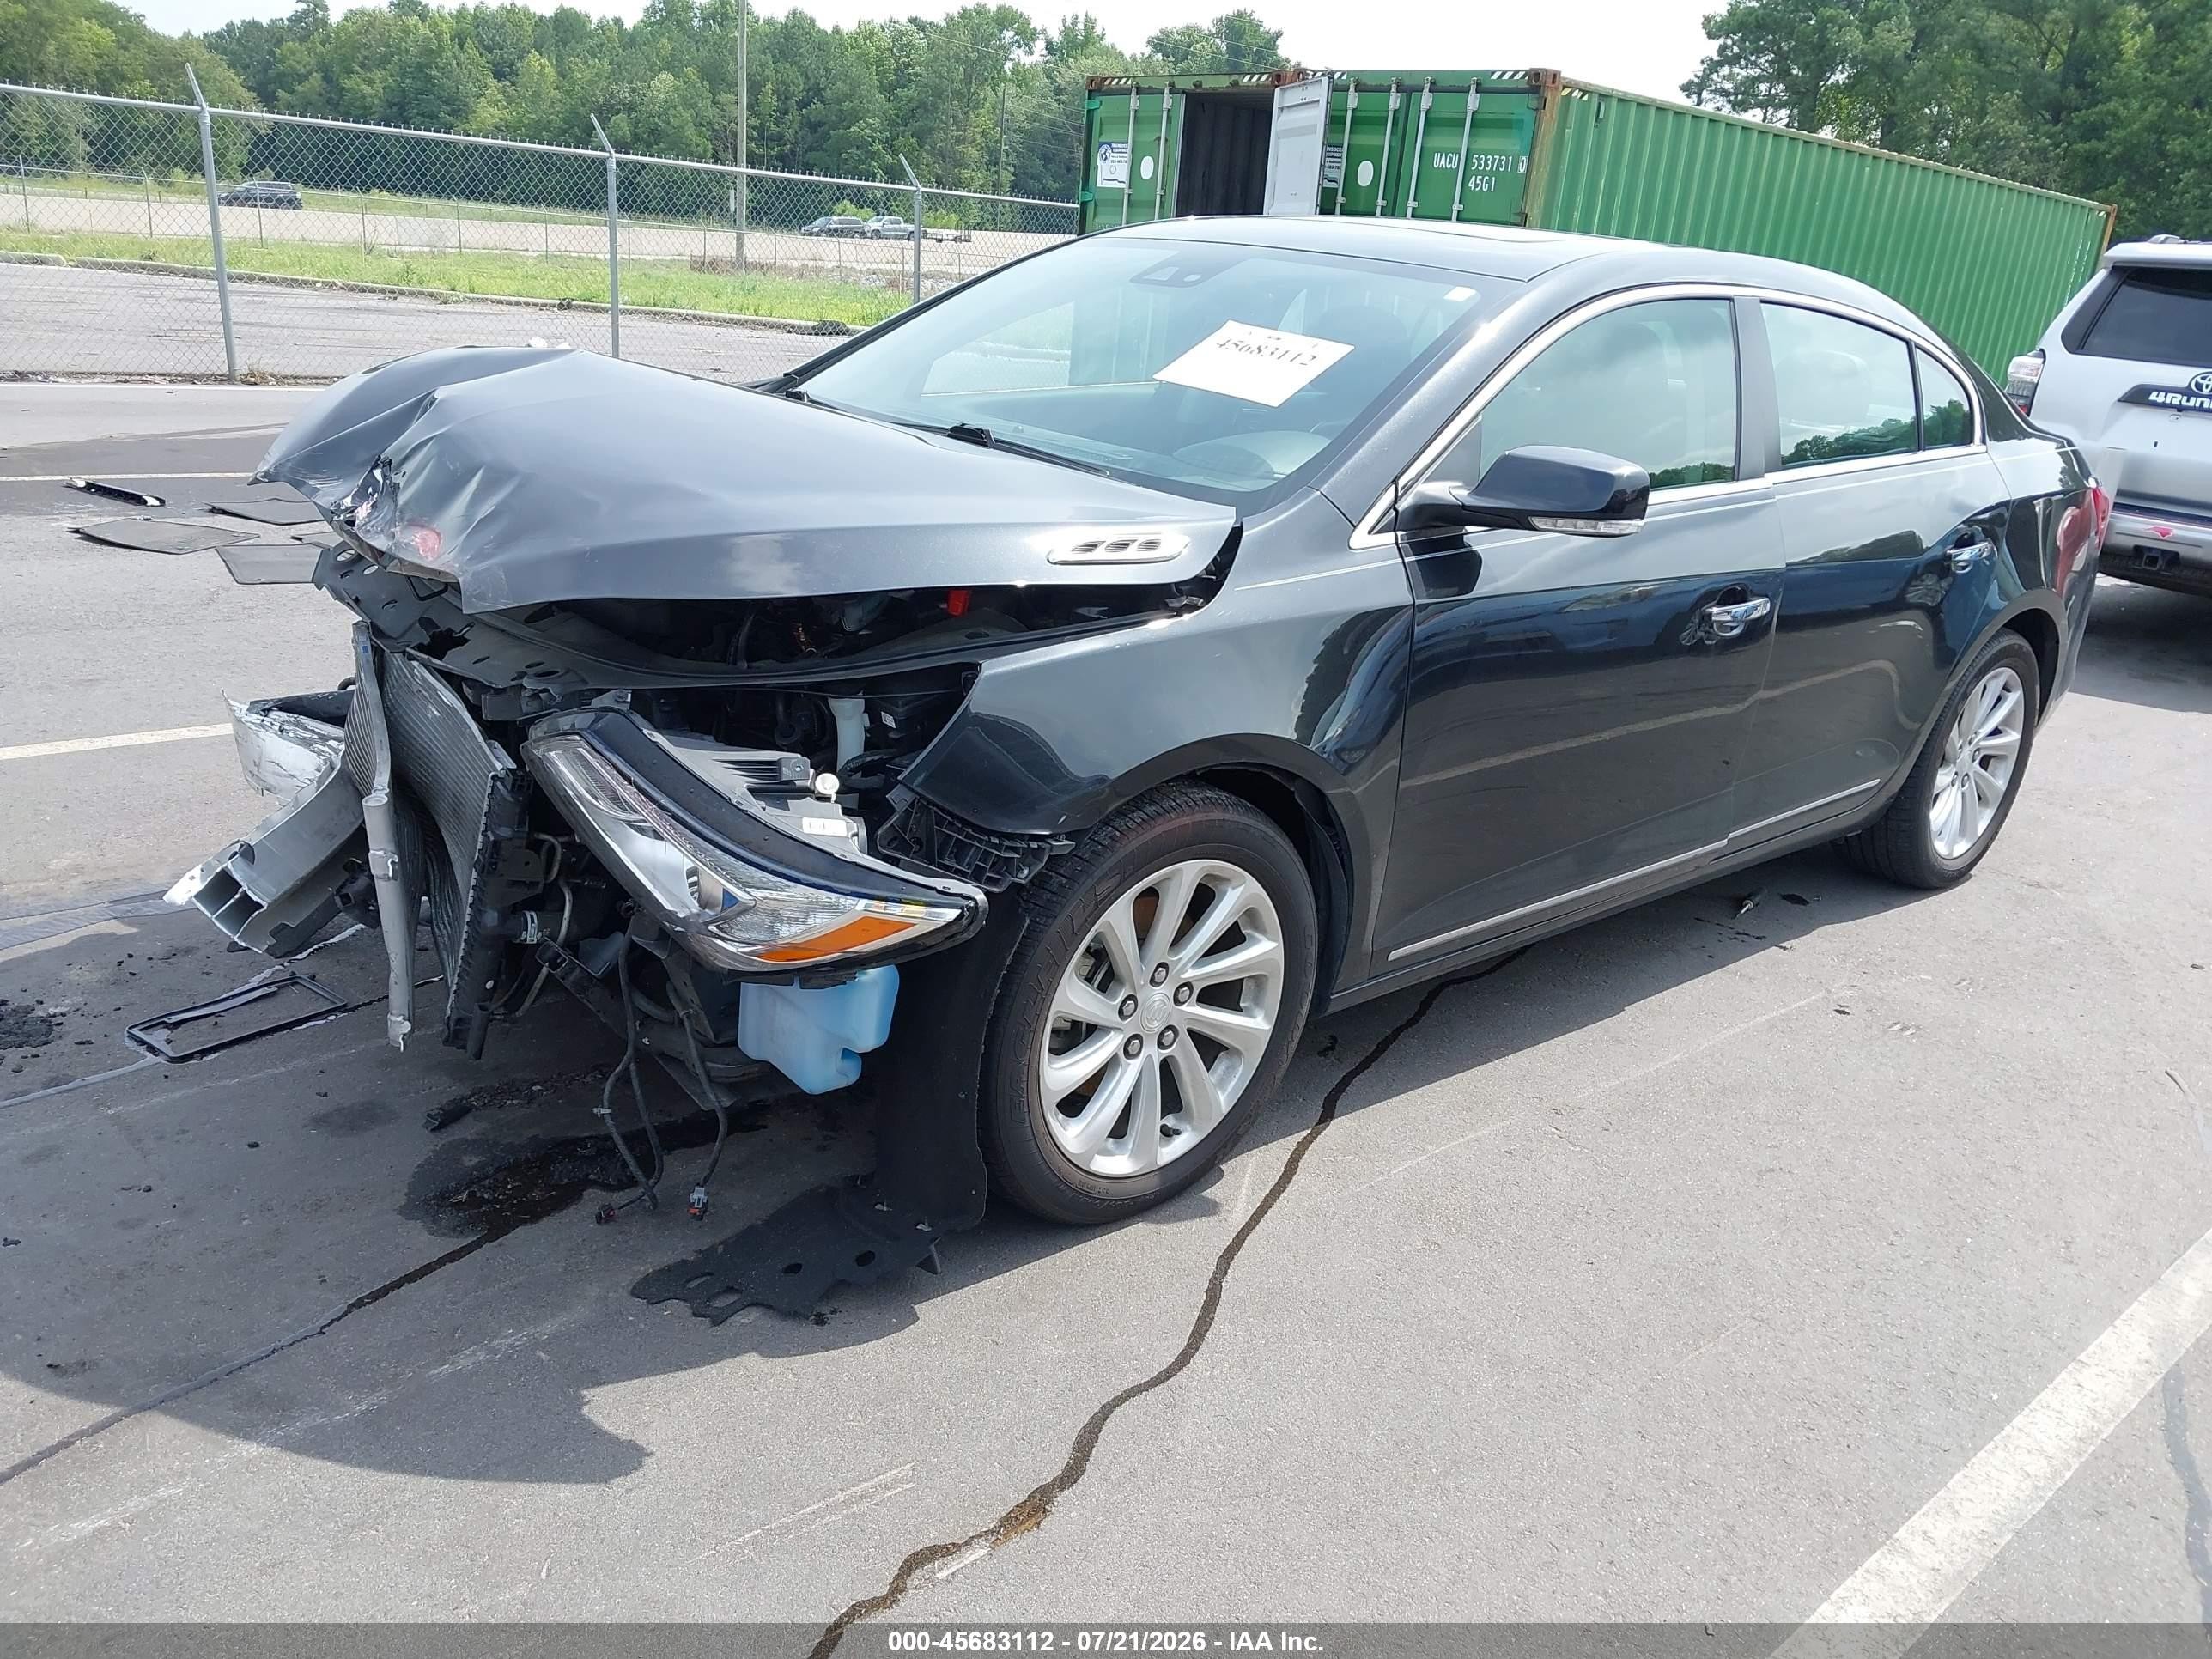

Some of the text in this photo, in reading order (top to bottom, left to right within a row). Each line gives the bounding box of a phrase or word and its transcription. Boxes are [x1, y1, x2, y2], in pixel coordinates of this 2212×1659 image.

[1433, 152, 1460, 169] UACU
[1471, 155, 1512, 172] 533731
[1468, 175, 1496, 192] 45G1
